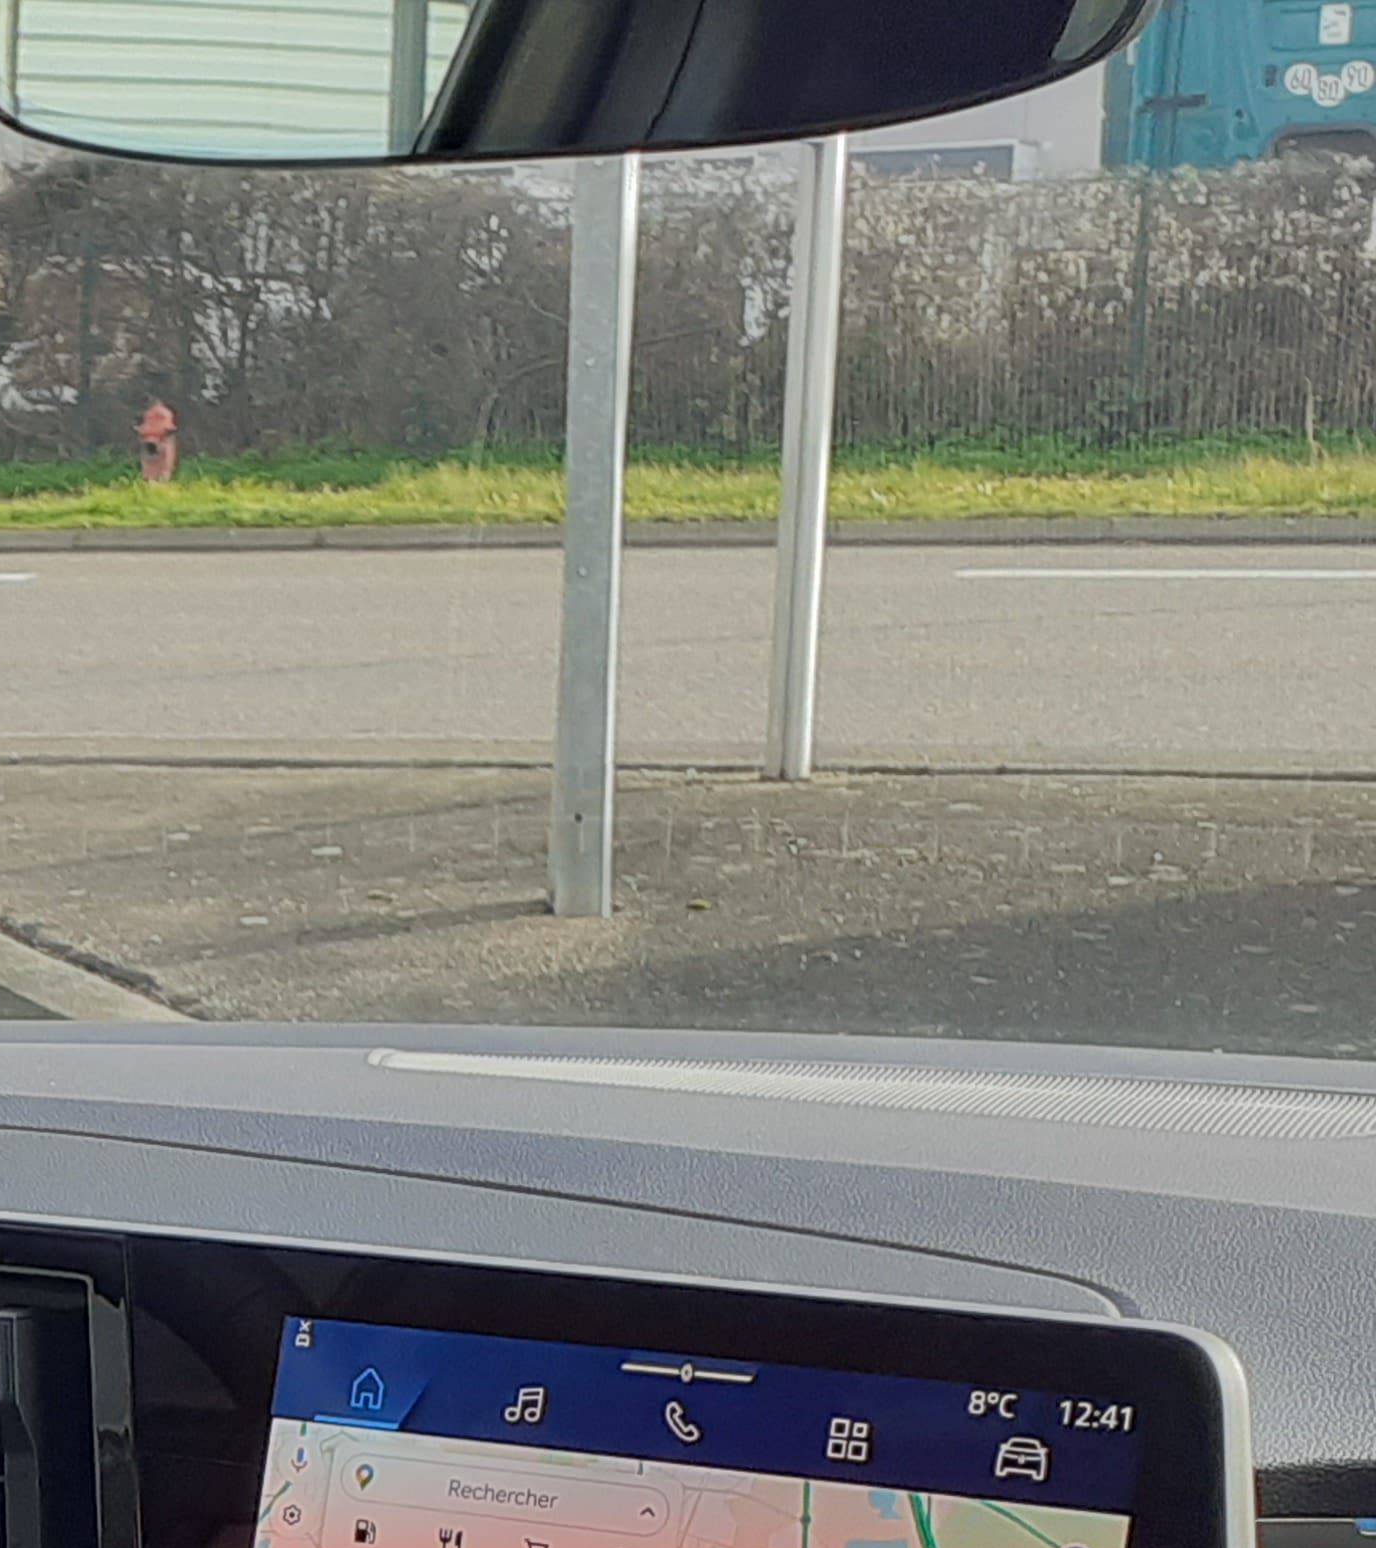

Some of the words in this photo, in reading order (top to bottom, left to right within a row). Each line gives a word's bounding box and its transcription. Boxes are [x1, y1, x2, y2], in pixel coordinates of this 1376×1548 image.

[968, 1389, 1018, 1420] 8°C
[1059, 1399, 1135, 1433] 12:41
[447, 1478, 559, 1510] Rechercher
